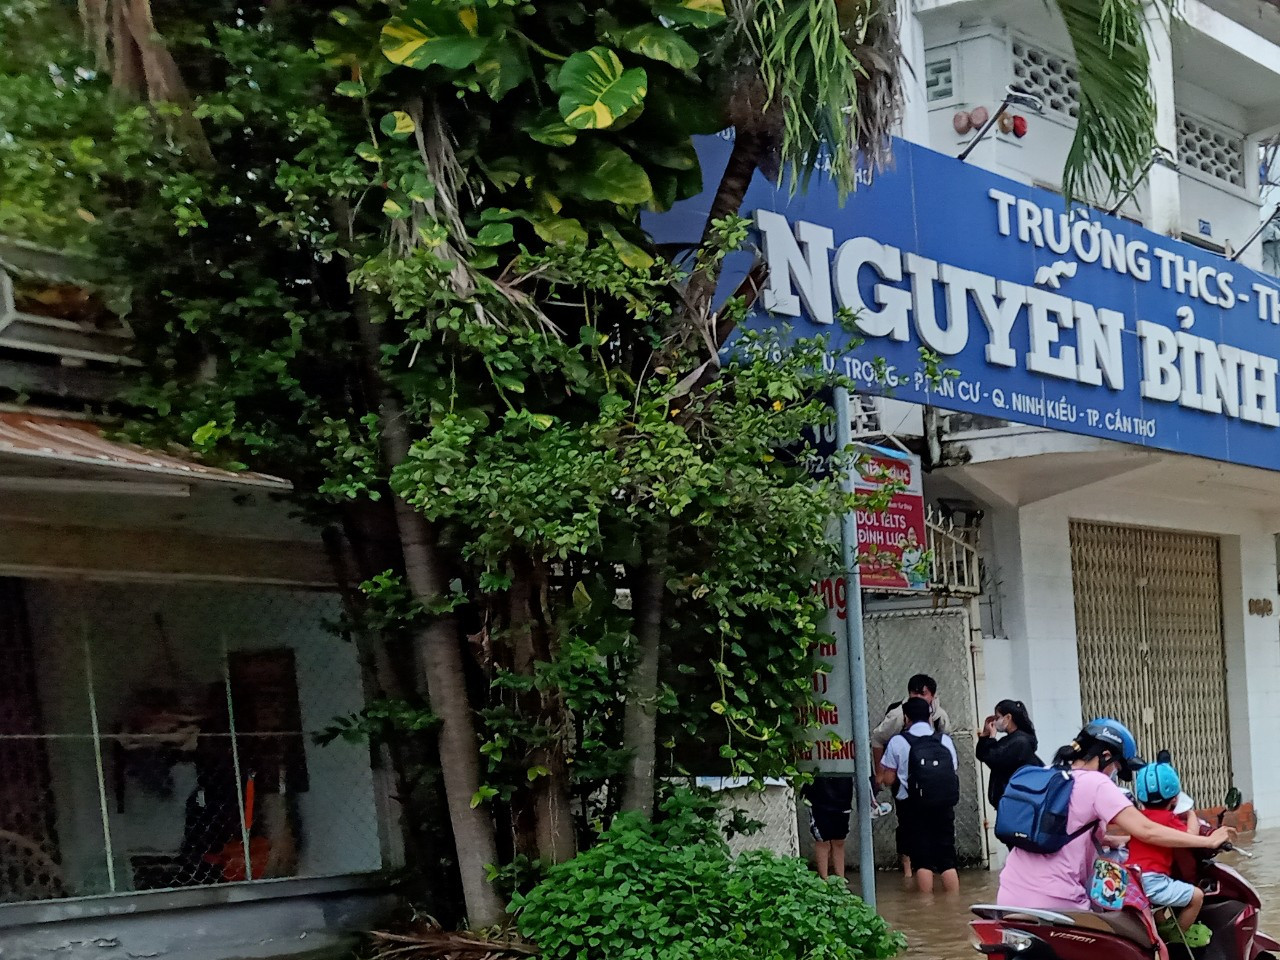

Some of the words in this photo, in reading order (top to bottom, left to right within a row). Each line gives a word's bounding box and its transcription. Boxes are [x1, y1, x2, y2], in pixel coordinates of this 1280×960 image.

[988, 188, 1151, 282] TRƯỜNG
[1153, 247, 1236, 309] THCS
[755, 208, 1125, 391] NGUYỄN
[1136, 305, 1280, 428] BỈNH
[843, 356, 898, 387] TRỌG
[958, 381, 980, 403] CƯ
[992, 388, 1009, 409] Q.
[1012, 392, 1045, 417] NINH
[1087, 408, 1103, 429] TP.
[1133, 417, 1156, 438] THƠ
